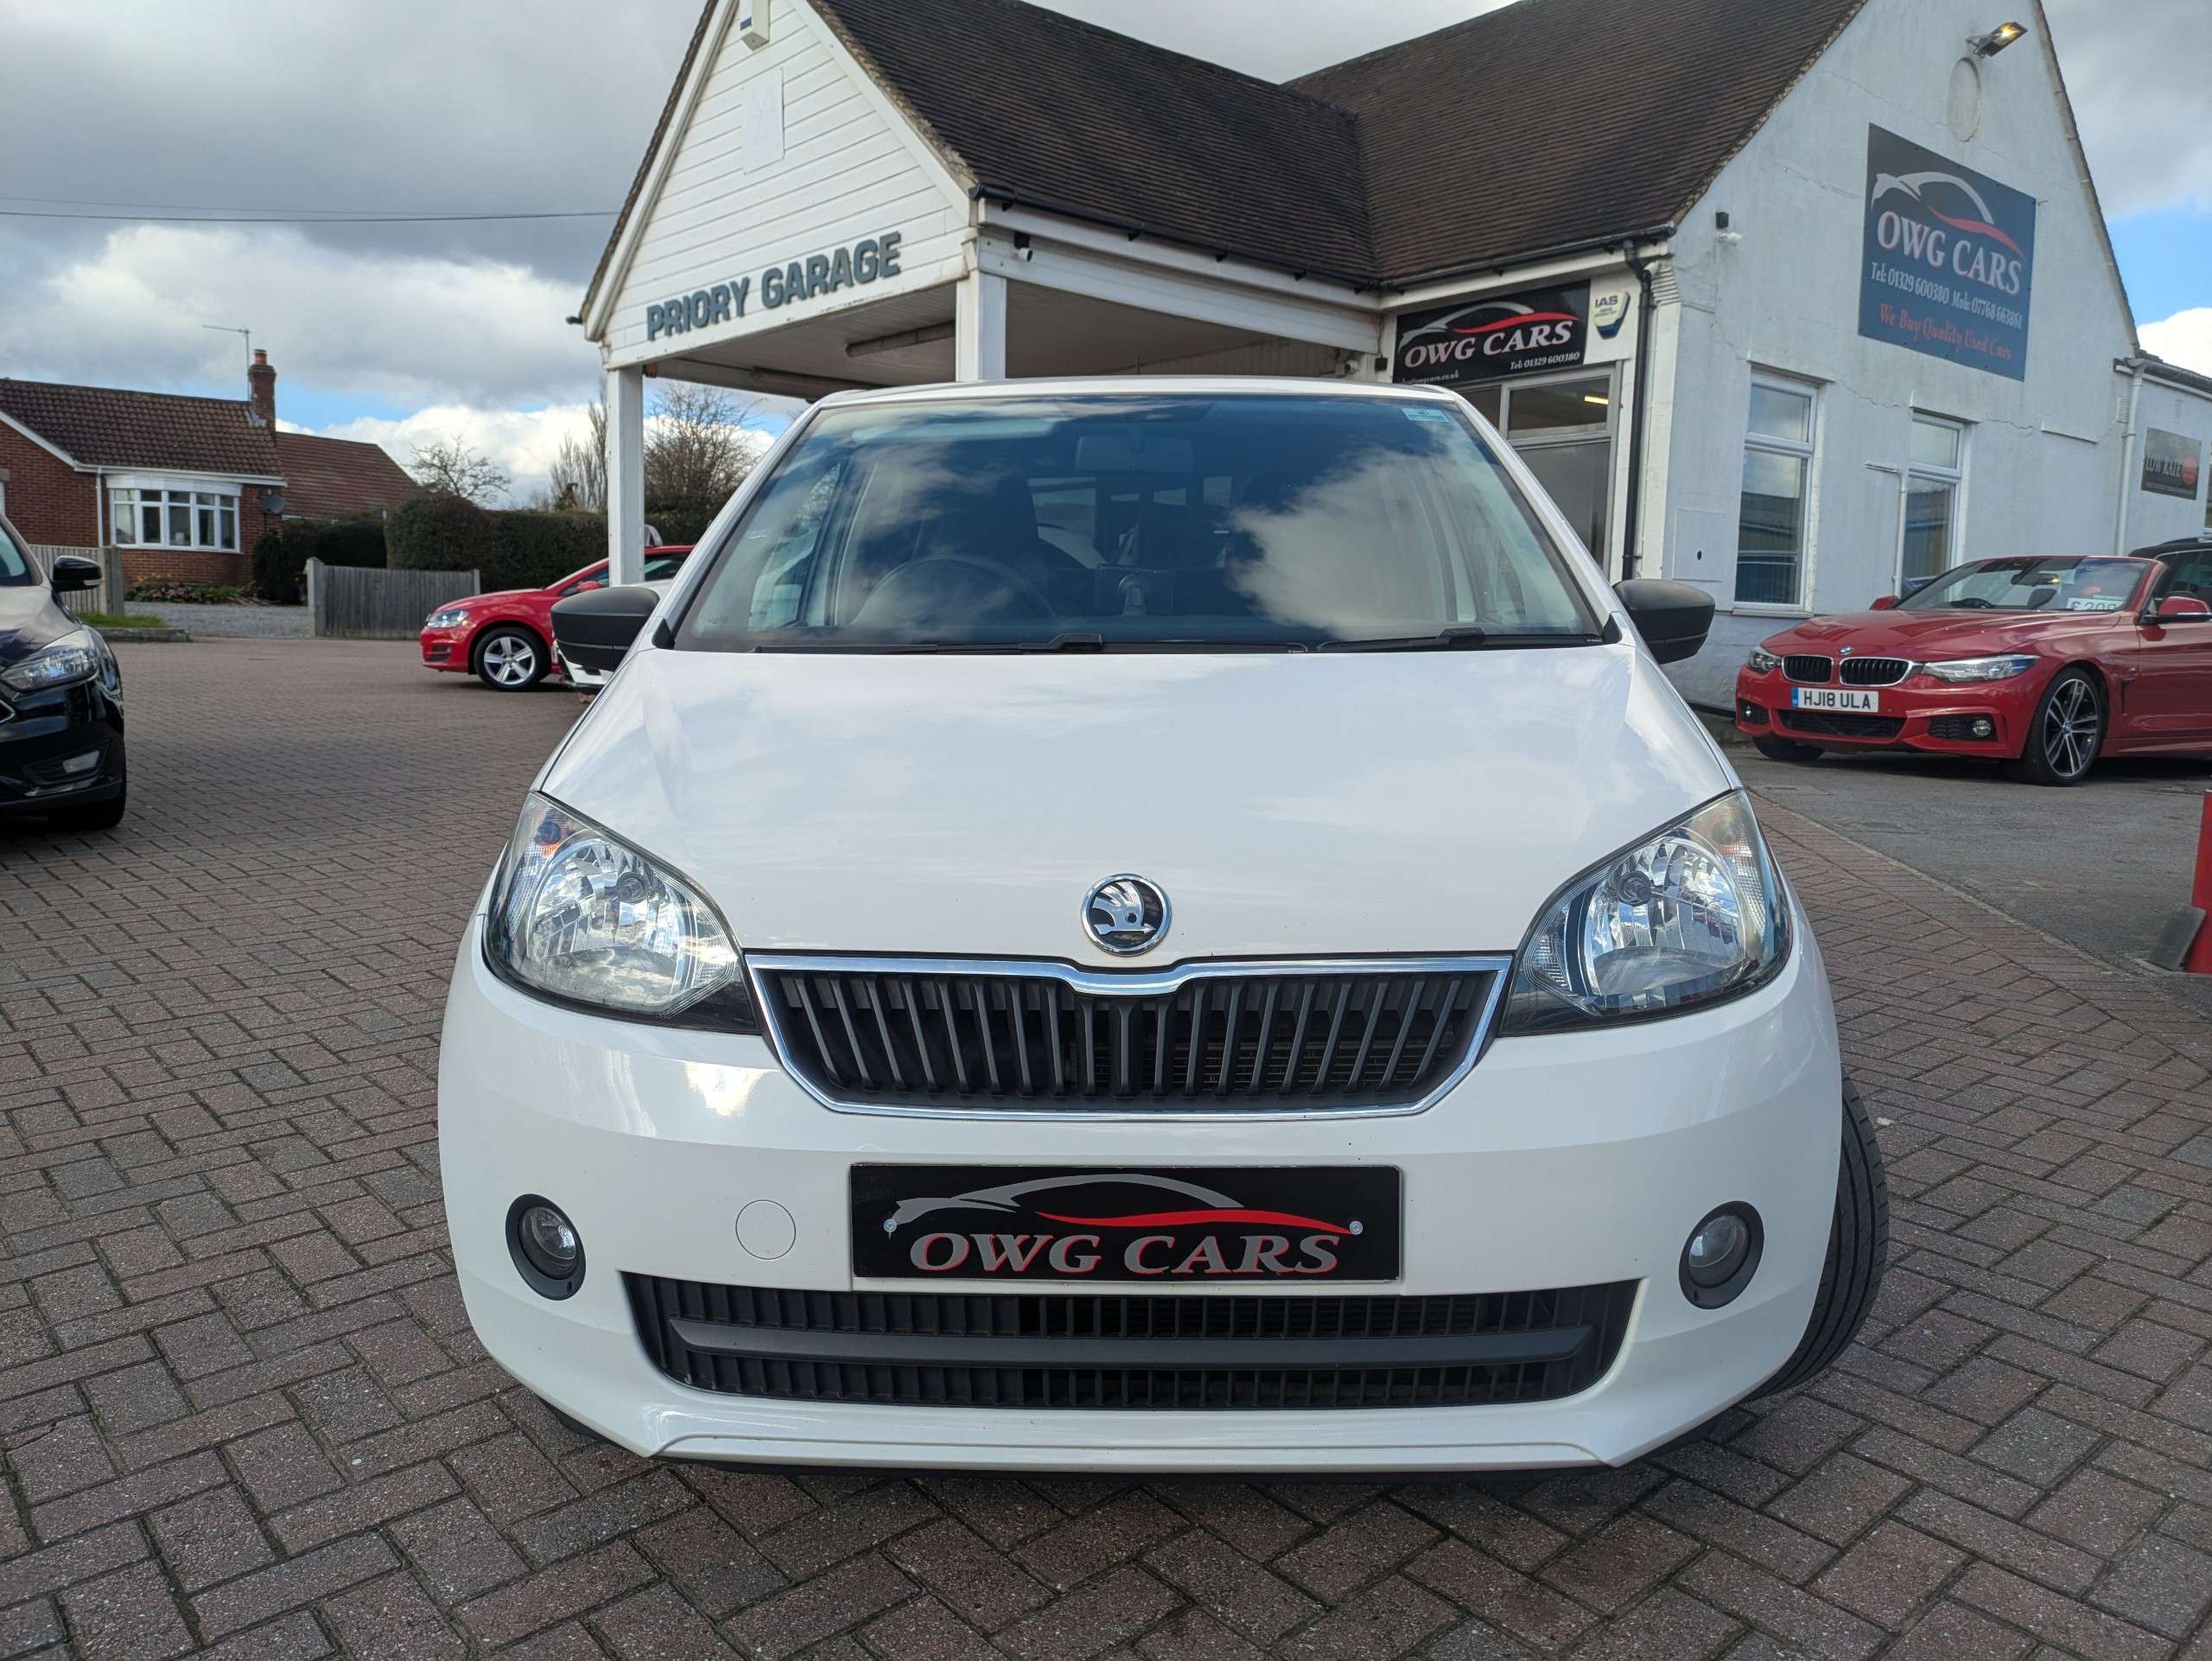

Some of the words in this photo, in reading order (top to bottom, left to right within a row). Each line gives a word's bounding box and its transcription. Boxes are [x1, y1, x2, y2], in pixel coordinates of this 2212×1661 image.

[1877, 211, 1946, 267] OWG
[1952, 239, 2023, 296] CARS
[646, 276, 750, 342] PRIORY
[761, 231, 901, 309] GARAGE
[1595, 295, 1618, 309] IAS
[1888, 267, 1914, 293] 01329
[1915, 277, 1949, 304] 600380
[1404, 338, 1475, 369] OWG
[1483, 321, 1573, 356] CARS
[1523, 356, 1548, 368] 01329
[1803, 691, 1835, 707] HJ18
[1840, 693, 1872, 710] ULA
[909, 1232, 1103, 1273] OWG
[1123, 1232, 1341, 1276] CARS
